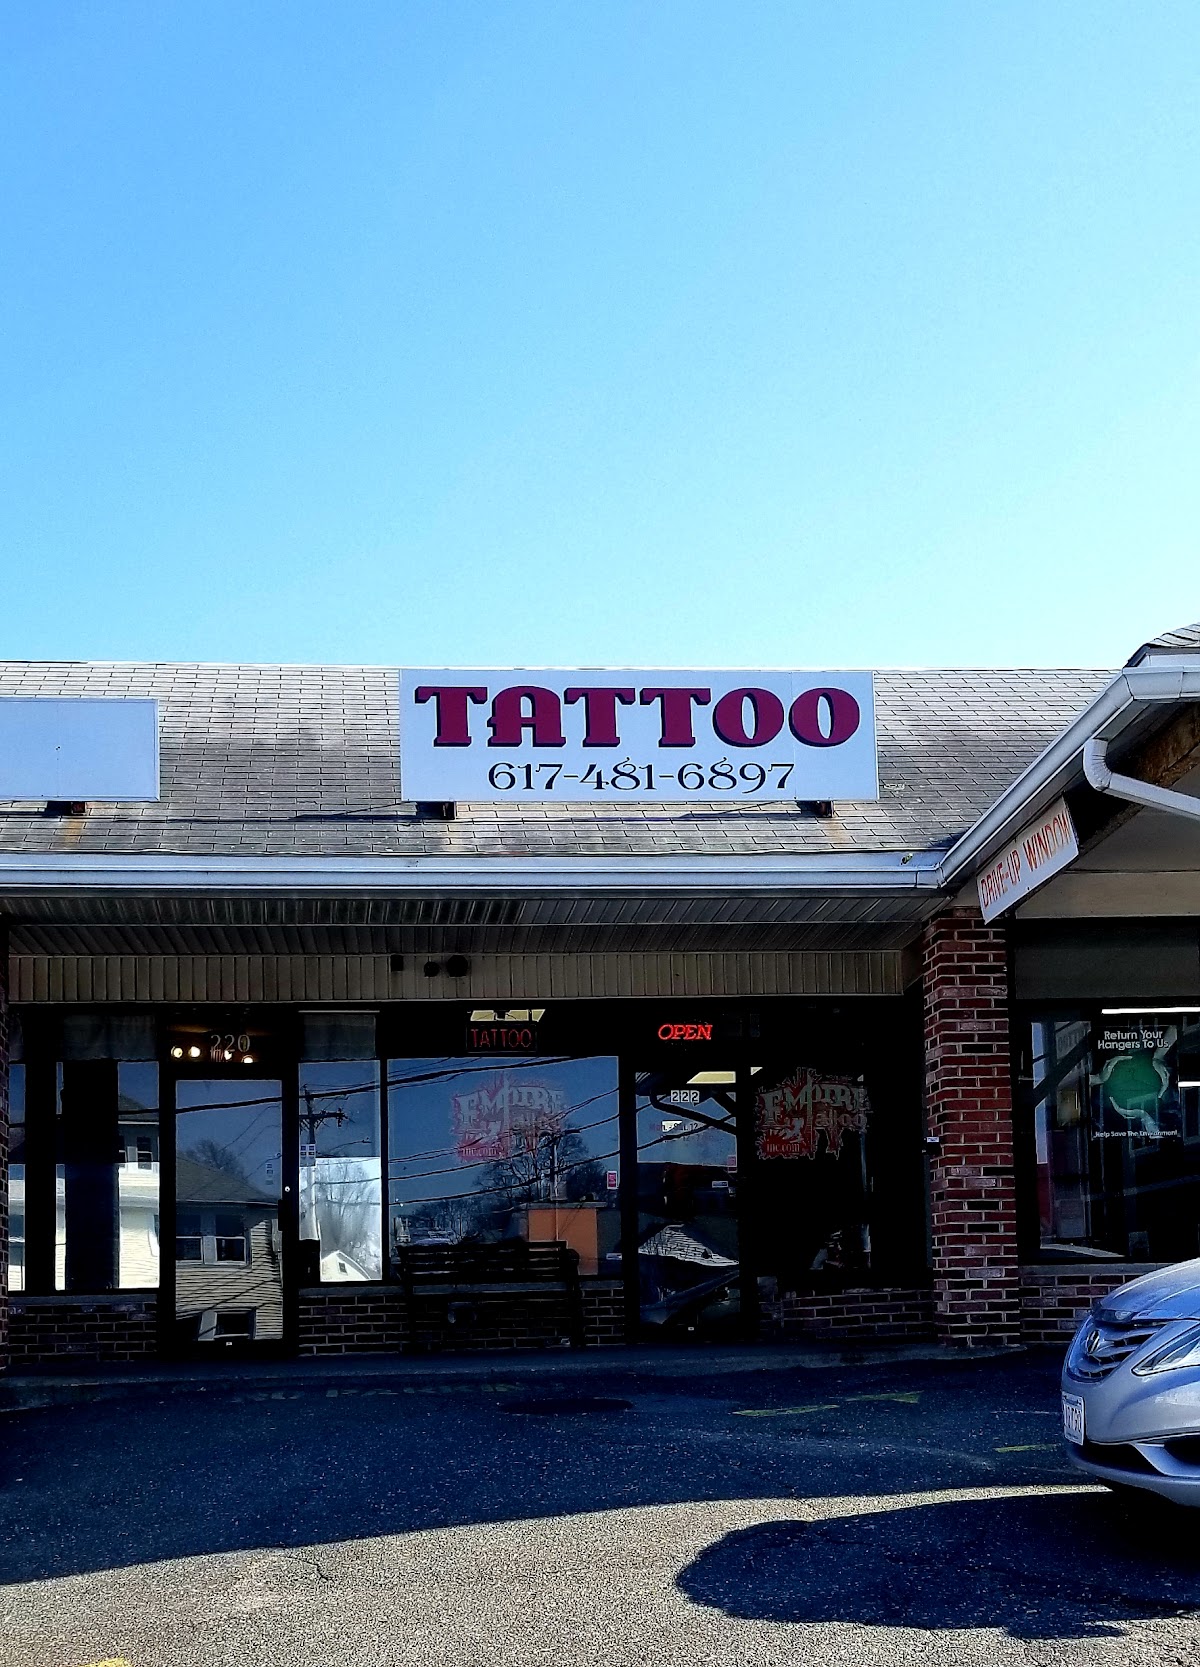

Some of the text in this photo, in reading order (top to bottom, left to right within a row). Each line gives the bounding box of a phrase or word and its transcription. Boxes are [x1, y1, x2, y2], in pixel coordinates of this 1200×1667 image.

[413, 685, 861, 748] TATTOO
[487, 756, 795, 795] 617-481-6897
[980, 810, 1070, 909] DRIVE-UP WINDOW
[470, 1028, 532, 1048] TATTOO
[658, 1024, 713, 1040] OPEN
[1104, 1029, 1163, 1040] Return Your
[210, 1034, 251, 1052] 220
[1098, 1040, 1140, 1050] Hangers
[1142, 1039, 1155, 1049] To
[671, 1090, 700, 1103] 222
